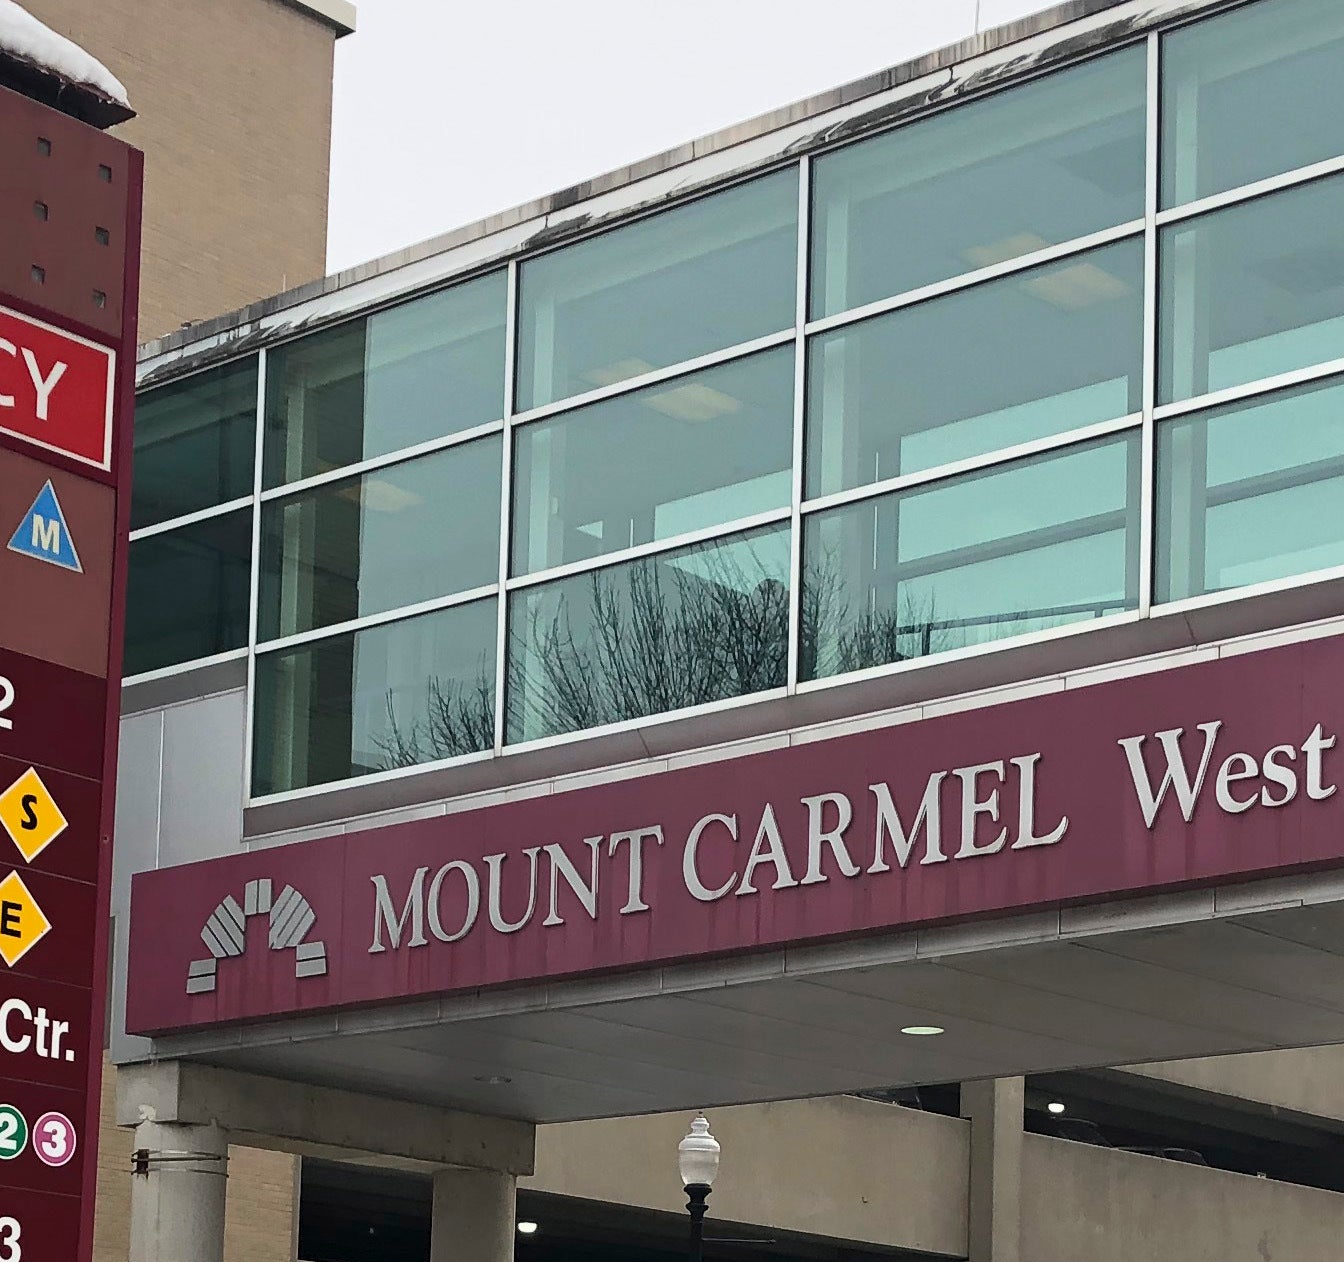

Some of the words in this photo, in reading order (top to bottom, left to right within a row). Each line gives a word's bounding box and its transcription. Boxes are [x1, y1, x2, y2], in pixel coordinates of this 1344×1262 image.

[31, 514, 59, 554] M
[21, 793, 38, 831] S
[368, 826, 664, 954] MOUNT
[682, 752, 1069, 901] CARMEL
[1118, 721, 1336, 830] West
[0, 899, 22, 939] E
[42, 1121, 65, 1156] 3
